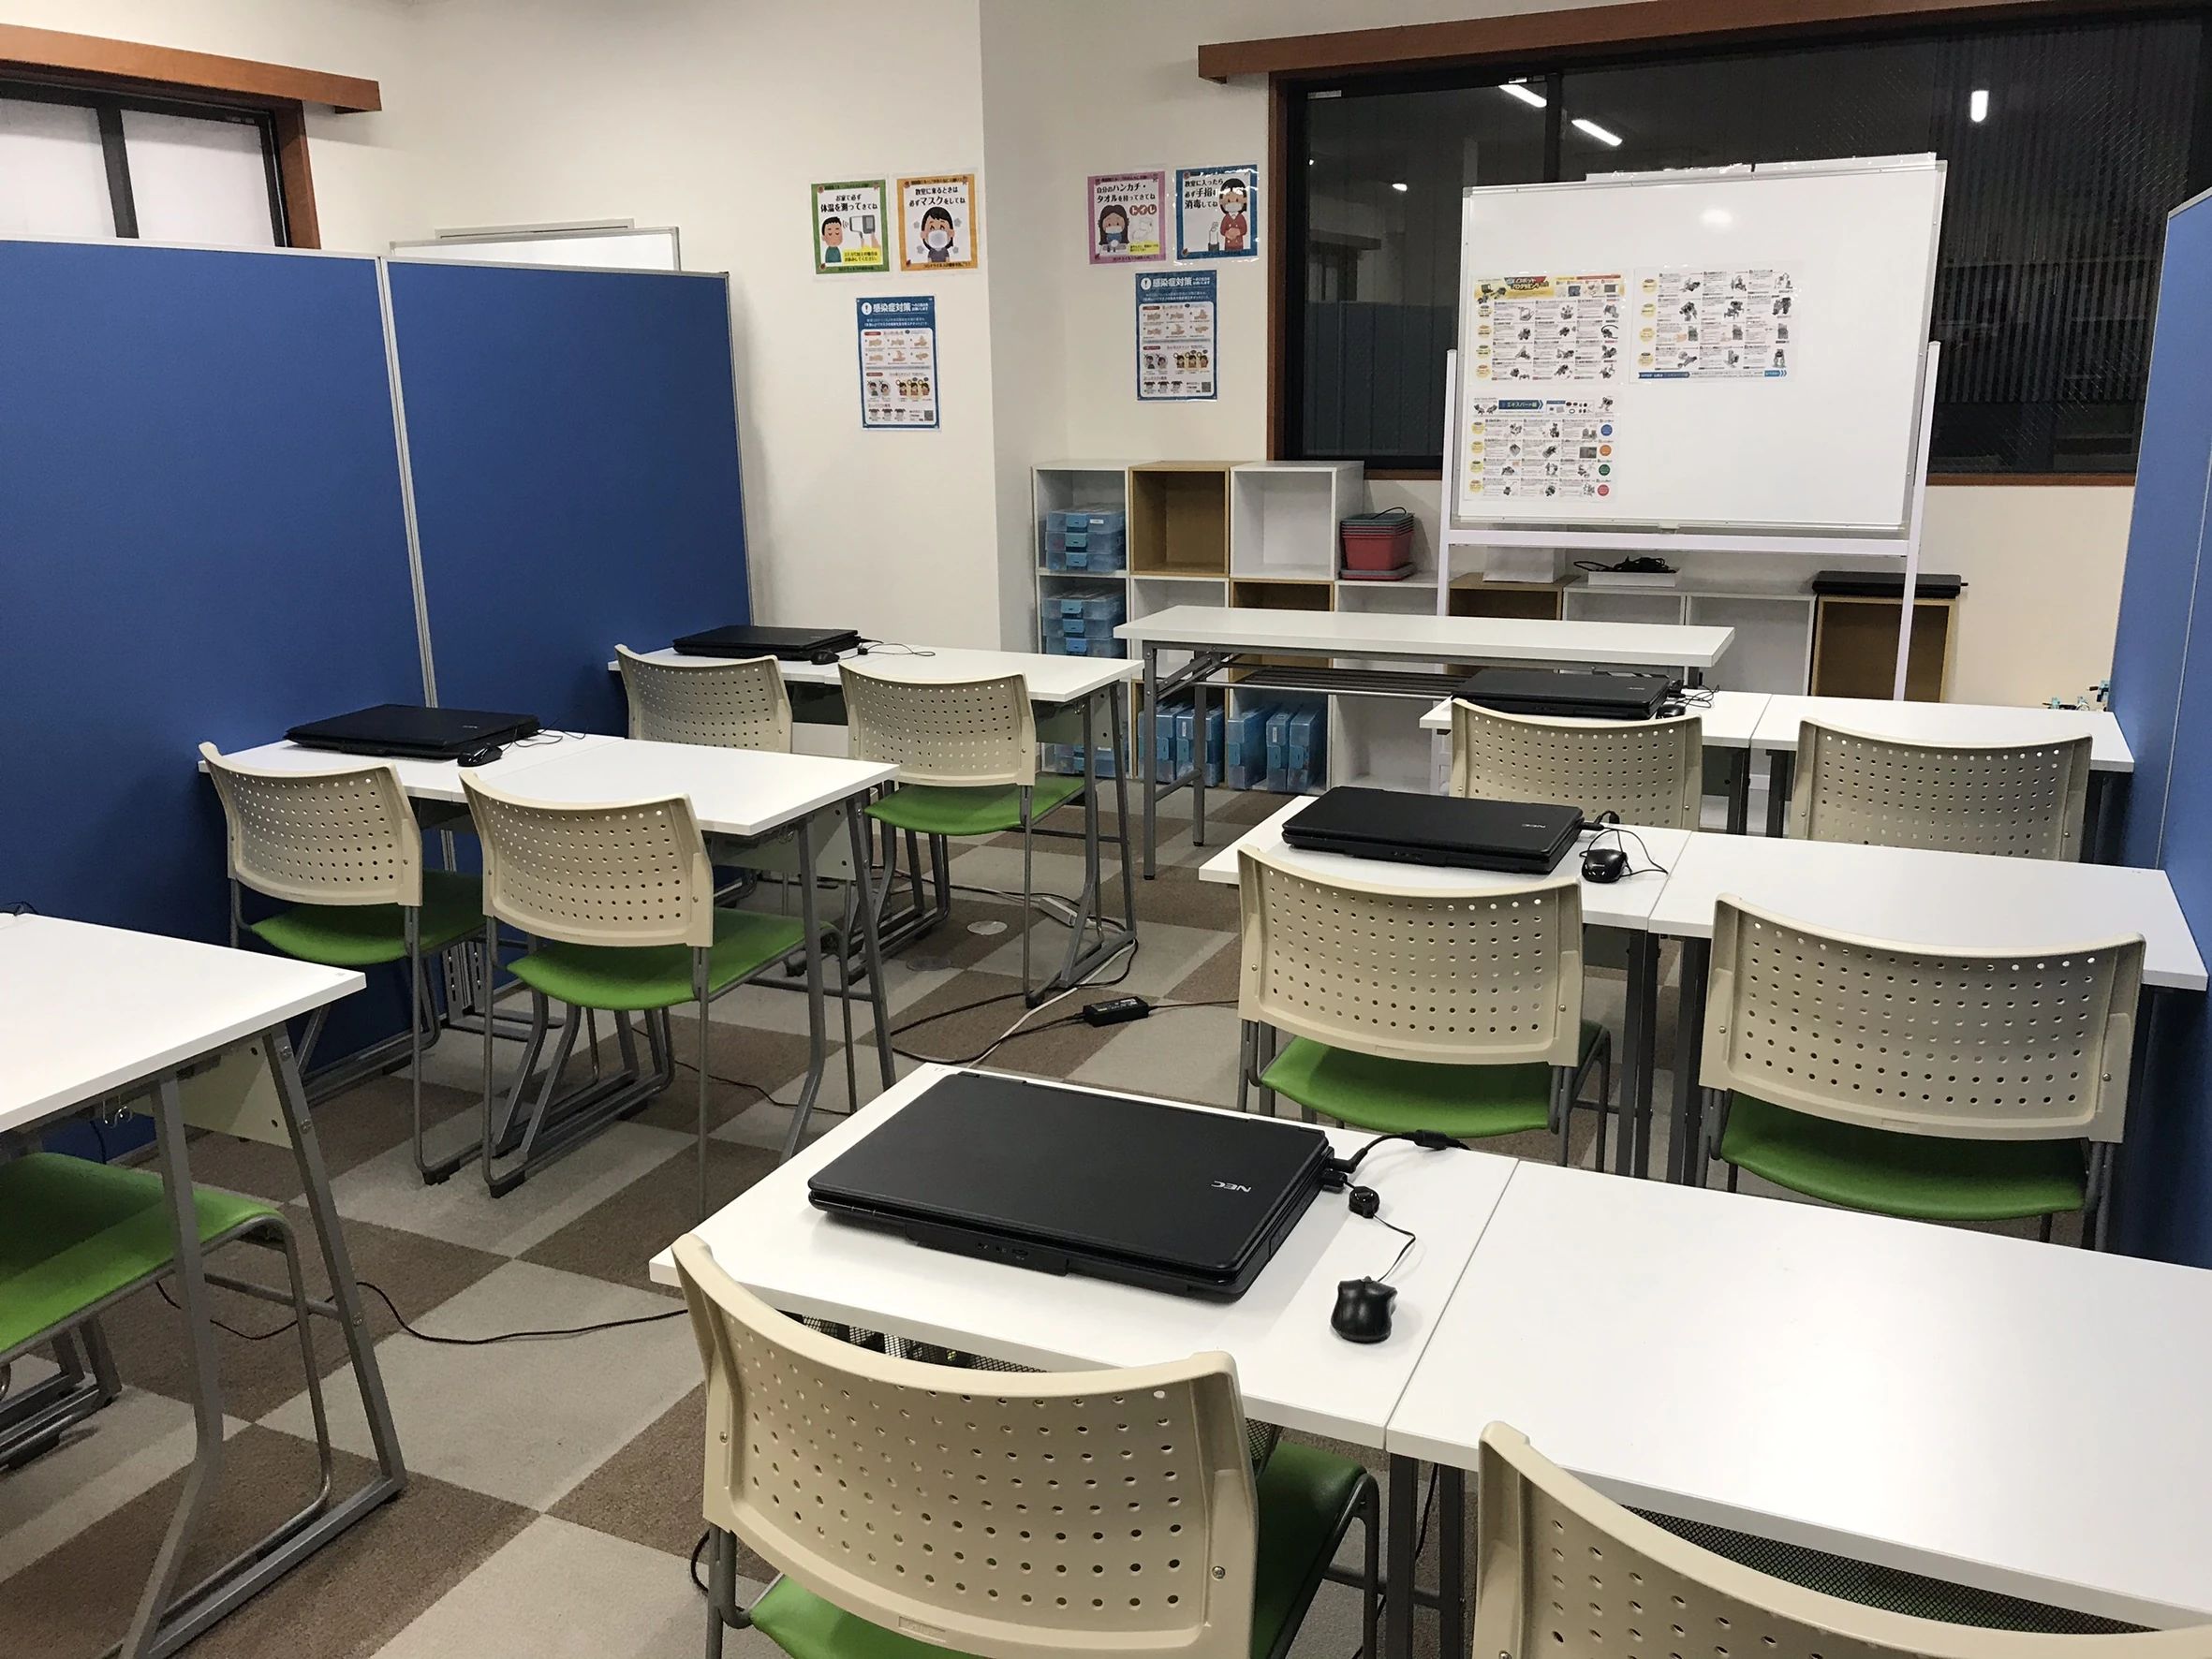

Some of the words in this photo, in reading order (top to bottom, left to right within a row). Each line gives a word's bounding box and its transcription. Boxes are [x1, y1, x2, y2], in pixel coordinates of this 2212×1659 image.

[1185, 179, 1223, 187] 教室に入ったら
[915, 186, 958, 196] 教室に来るときは
[909, 196, 966, 207] 必ずマスクをしてね
[1097, 193, 1156, 203] タオルを持ってきてね
[820, 202, 878, 213] 体温を測ってきてね
[1185, 199, 1217, 209] 消毒してね
[1130, 205, 1157, 215] トイレ
[1152, 276, 1192, 287] 感染症対策
[873, 301, 911, 313] 感染症対策
[1211, 1180, 1251, 1193] NEC
